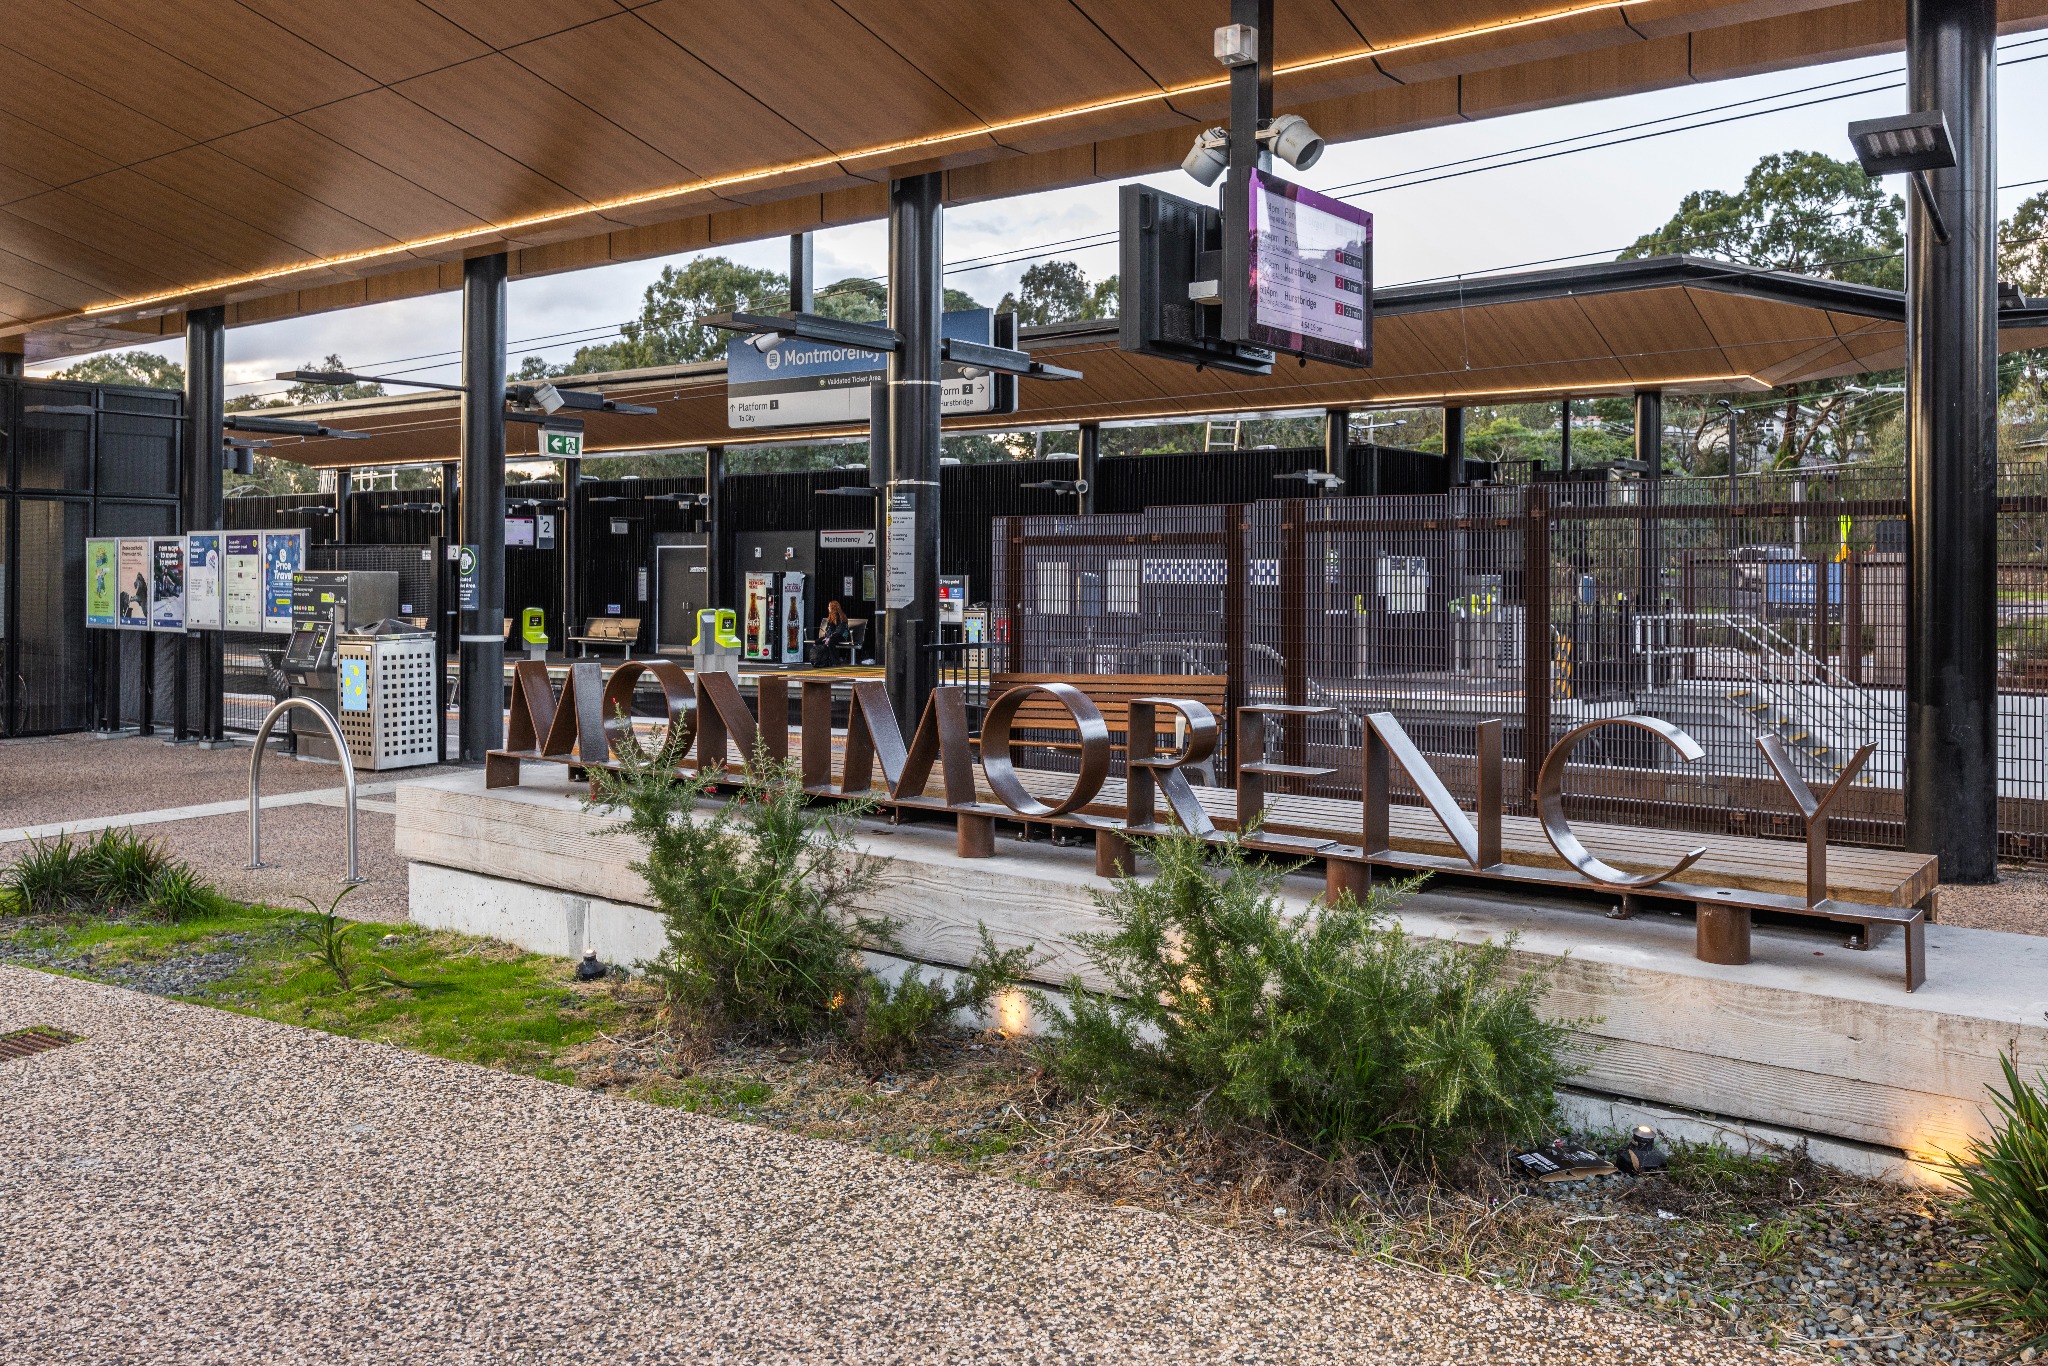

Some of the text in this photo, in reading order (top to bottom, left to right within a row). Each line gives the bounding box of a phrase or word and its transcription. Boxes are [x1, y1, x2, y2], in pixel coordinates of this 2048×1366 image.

[1284, 263, 1317, 284] Hurstbridge
[1337, 278, 1342, 288] 2
[1284, 291, 1317, 310] Hurstbridge
[1337, 304, 1342, 314] 2
[784, 348, 880, 366] Montmorency
[827, 374, 882, 386] Validated Ticket Area
[738, 401, 768, 412] Platform
[745, 414, 755, 422] City
[543, 521, 551, 533] 2
[824, 532, 874, 545] Montmorency 2
[452, 547, 457, 558] 2
[275, 559, 292, 570] Price
[506, 660, 1878, 909] MONTMORENCY
